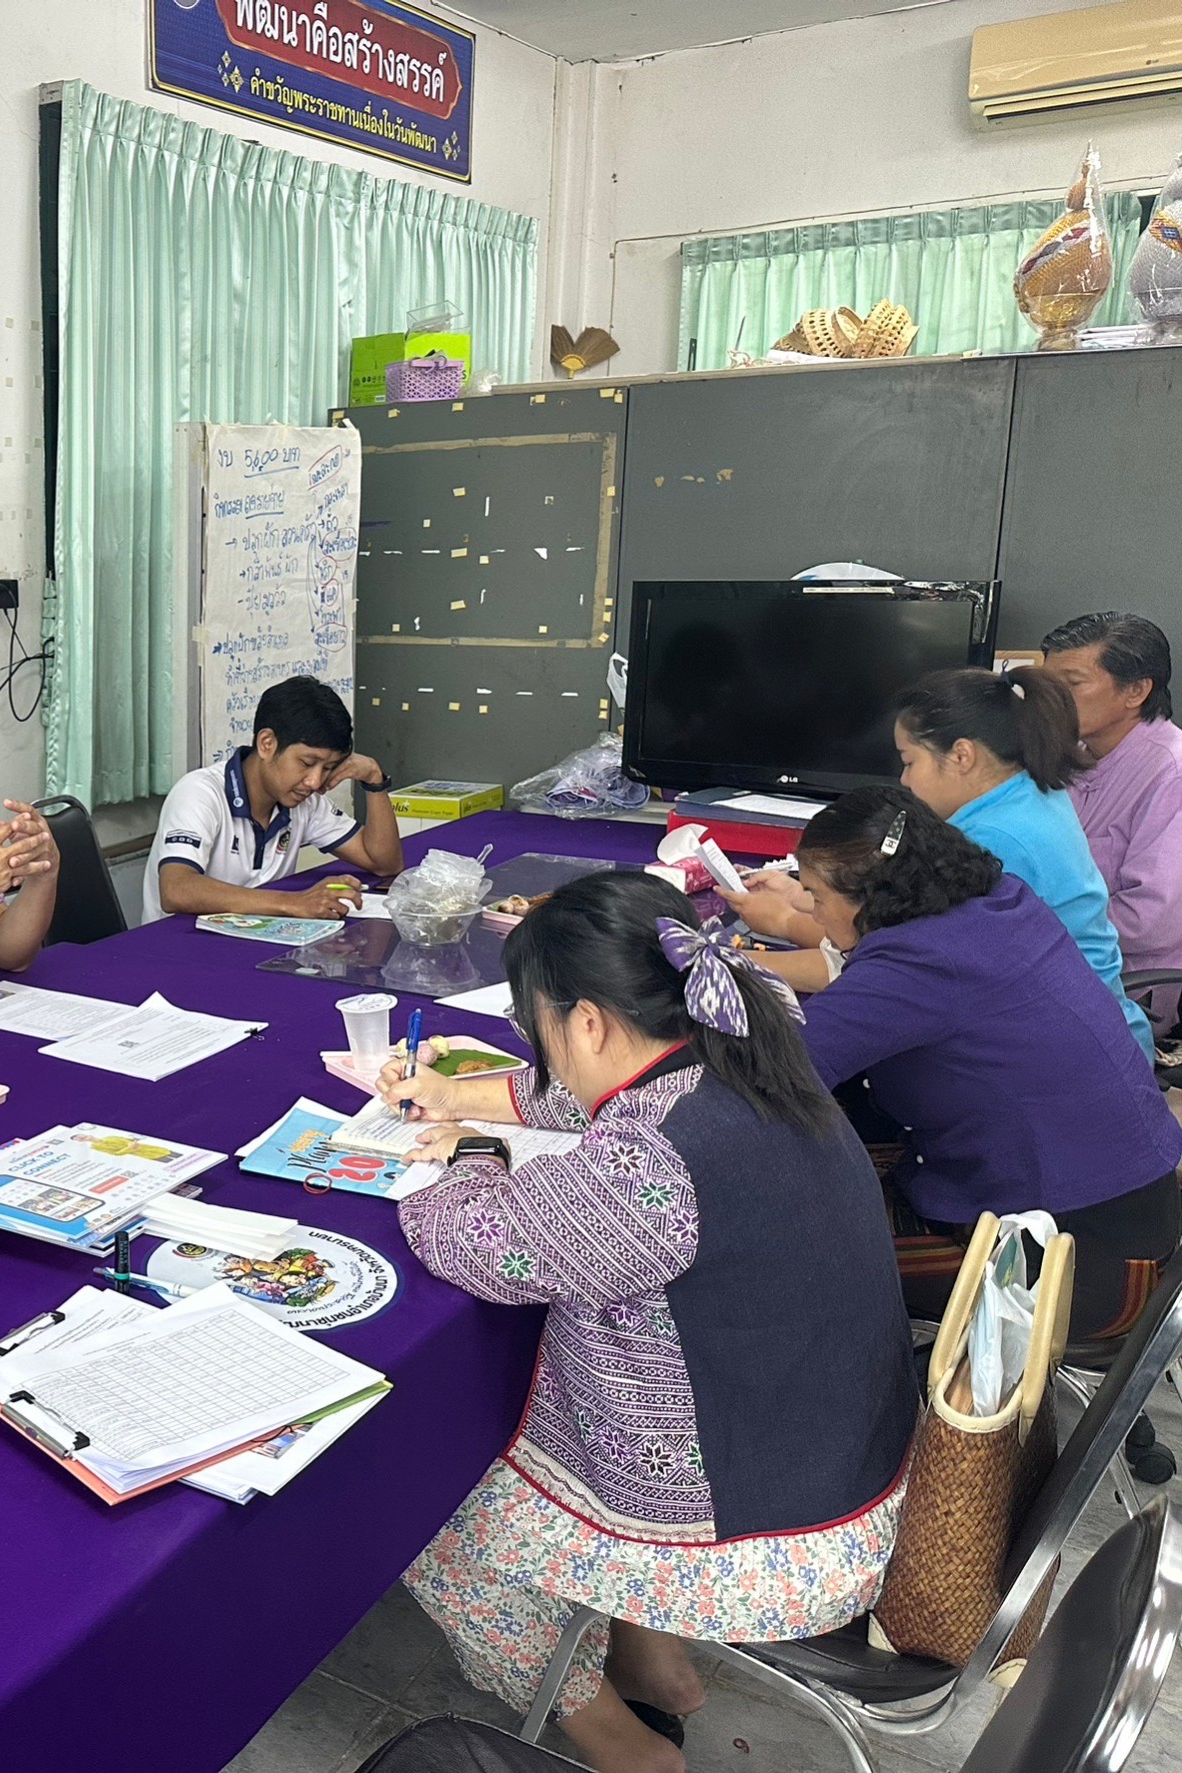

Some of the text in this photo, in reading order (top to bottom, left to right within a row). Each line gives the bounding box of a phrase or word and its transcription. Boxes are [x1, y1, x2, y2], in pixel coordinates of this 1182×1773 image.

[235, 0, 446, 102] พฒนาคือสร้างสรรค์
[250, 67, 437, 154] คำขวัญพระราชทานเนื่องในวันพัฒนา
